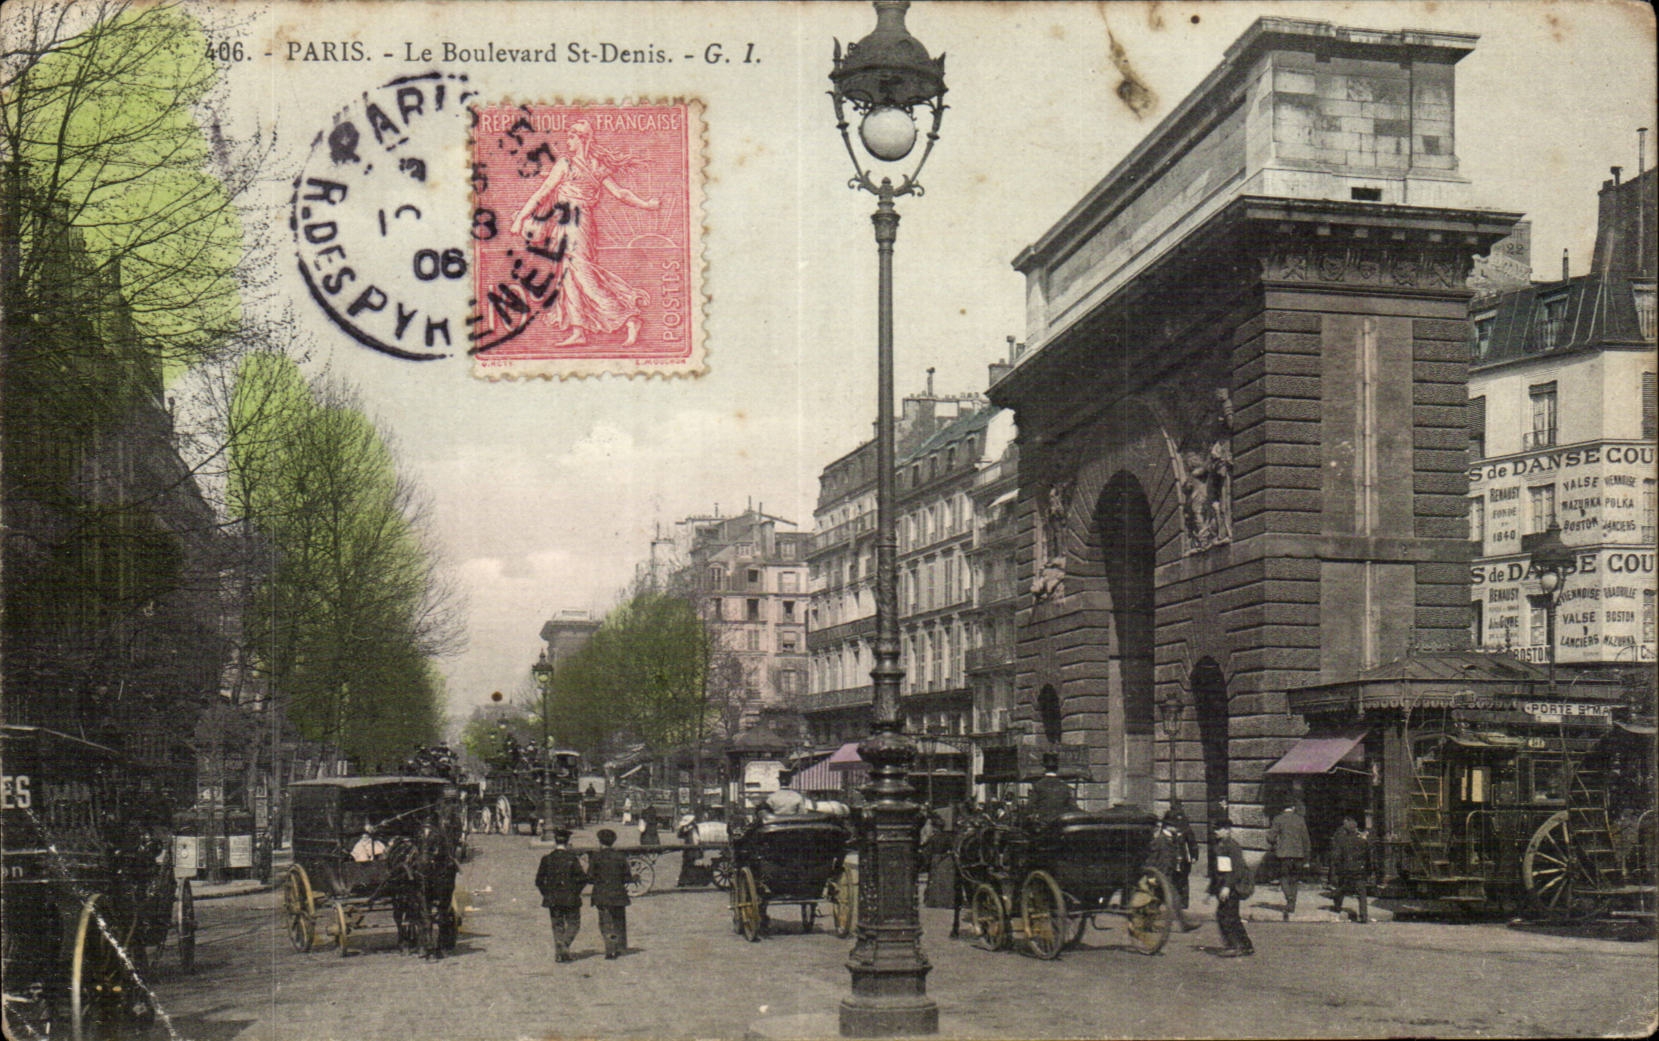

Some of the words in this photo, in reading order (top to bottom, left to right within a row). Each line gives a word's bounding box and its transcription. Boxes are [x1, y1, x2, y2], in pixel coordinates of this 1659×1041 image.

[413, 247, 468, 281] 06
[661, 259, 681, 342] POSTES
[1486, 464, 1508, 480] de
[1511, 450, 1601, 478] DANSE
[1562, 476, 1600, 492] VALSE
[1561, 498, 1601, 512] MAZURKA
[1605, 497, 1635, 509] POLKA
[1563, 517, 1599, 532] BOSTON
[1492, 529, 1517, 544] 1840
[1488, 566, 1505, 583] de
[1562, 611, 1597, 625] VALSE
[1606, 611, 1635, 623] BOSTON
[1559, 634, 1600, 649] LANCIERS
[1531, 703, 1573, 716] PORTE
